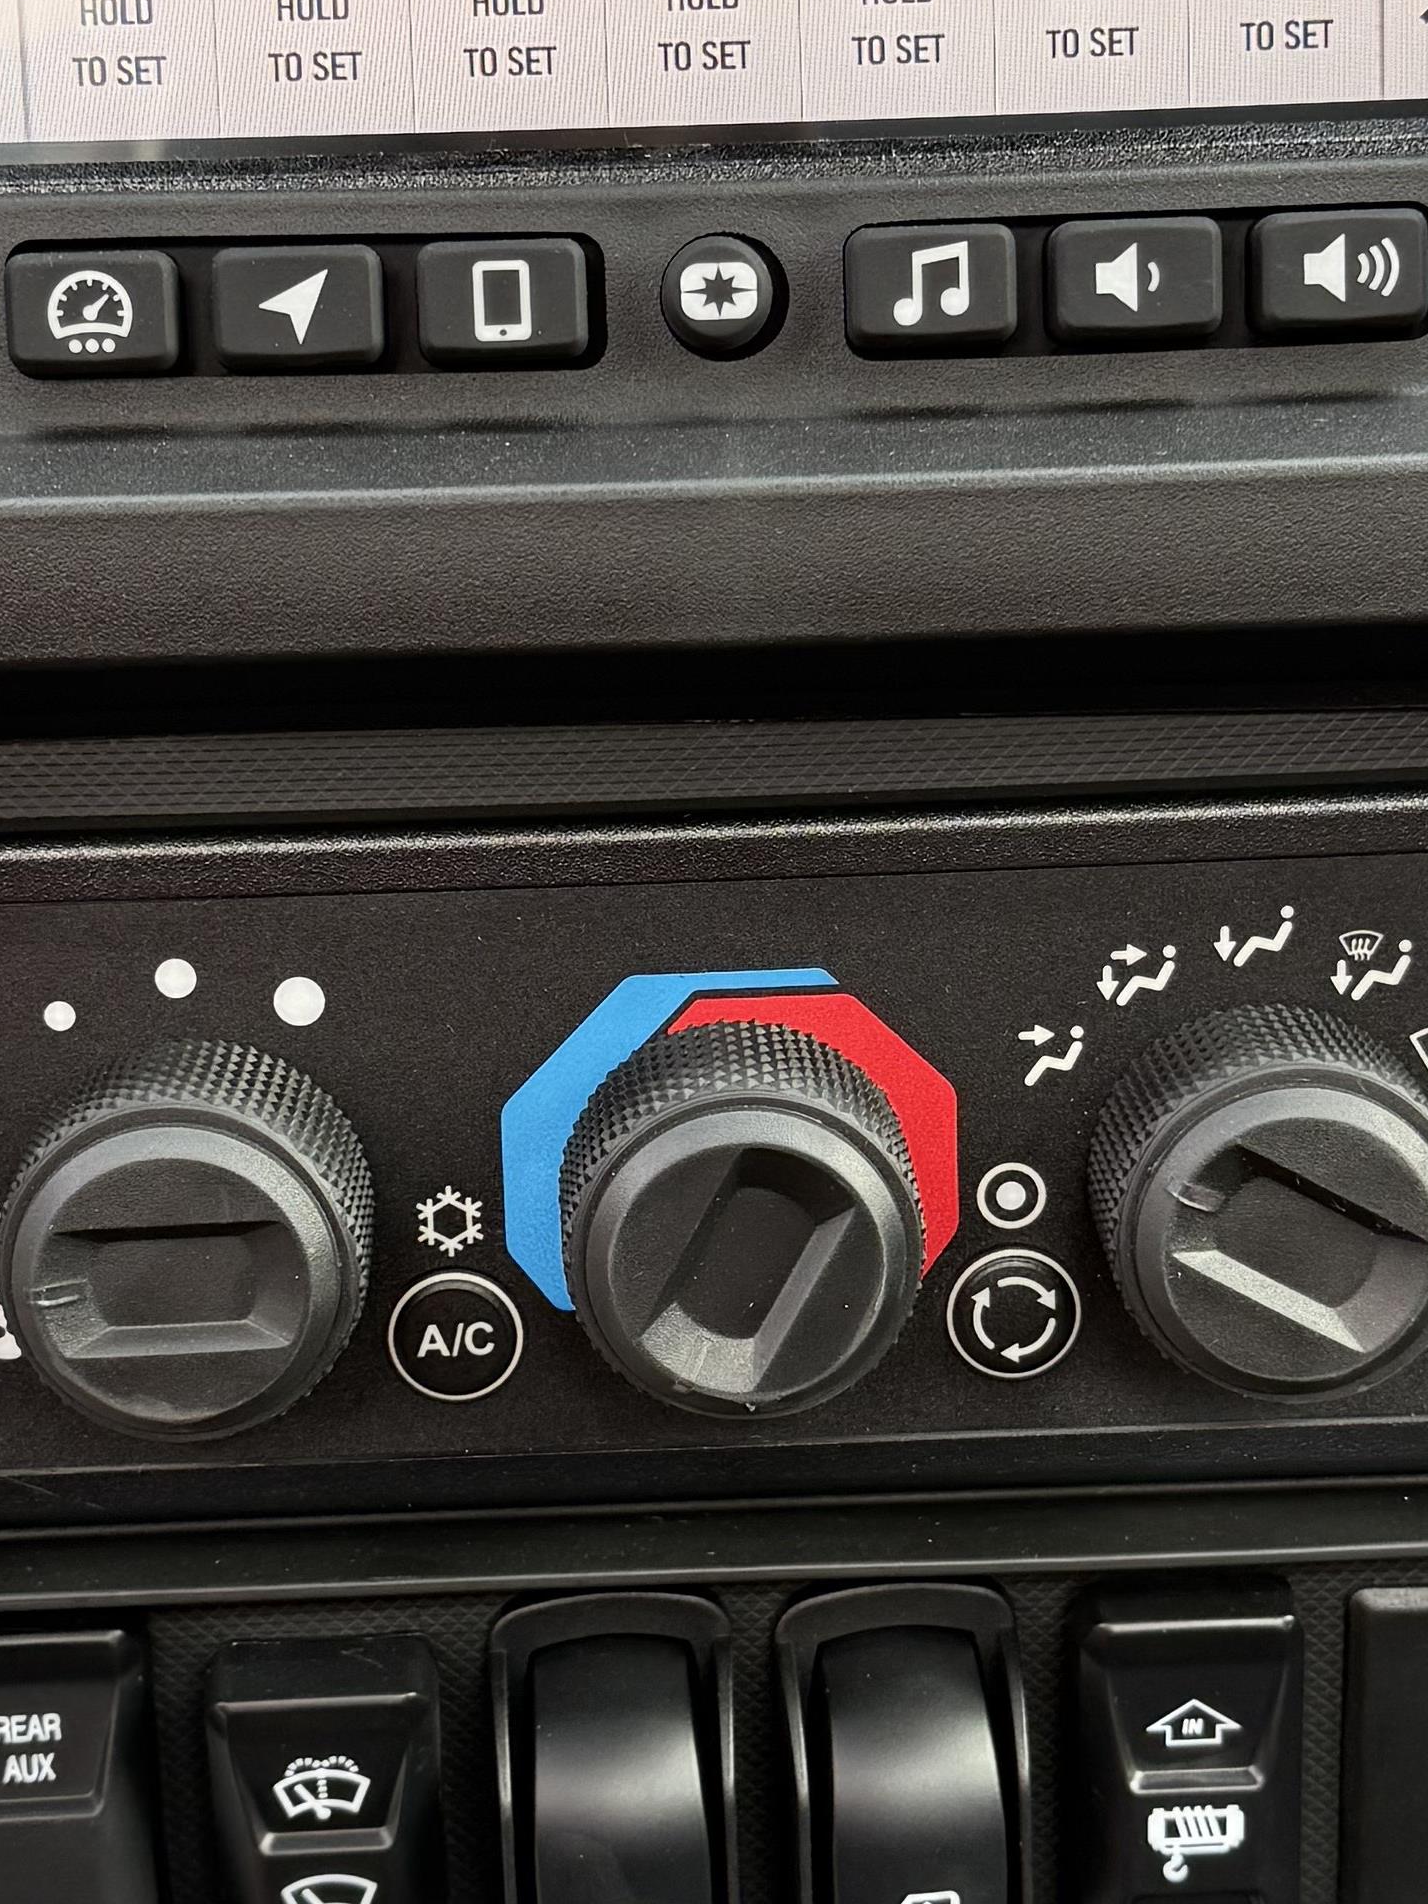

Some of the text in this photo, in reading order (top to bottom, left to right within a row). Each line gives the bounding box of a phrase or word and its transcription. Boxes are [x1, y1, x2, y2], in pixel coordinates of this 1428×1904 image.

[851, 34, 945, 65] TO SET
[1046, 26, 1139, 59] TO SET
[1240, 19, 1334, 51] TO SET
[72, 56, 167, 86] TO SET
[268, 51, 362, 82] TO SET
[463, 46, 557, 77] TO SET
[657, 40, 751, 72] TO SET
[417, 1321, 495, 1358] A/C
[1181, 1718, 1204, 1736] IN
[2, 1752, 57, 1784] AUX
